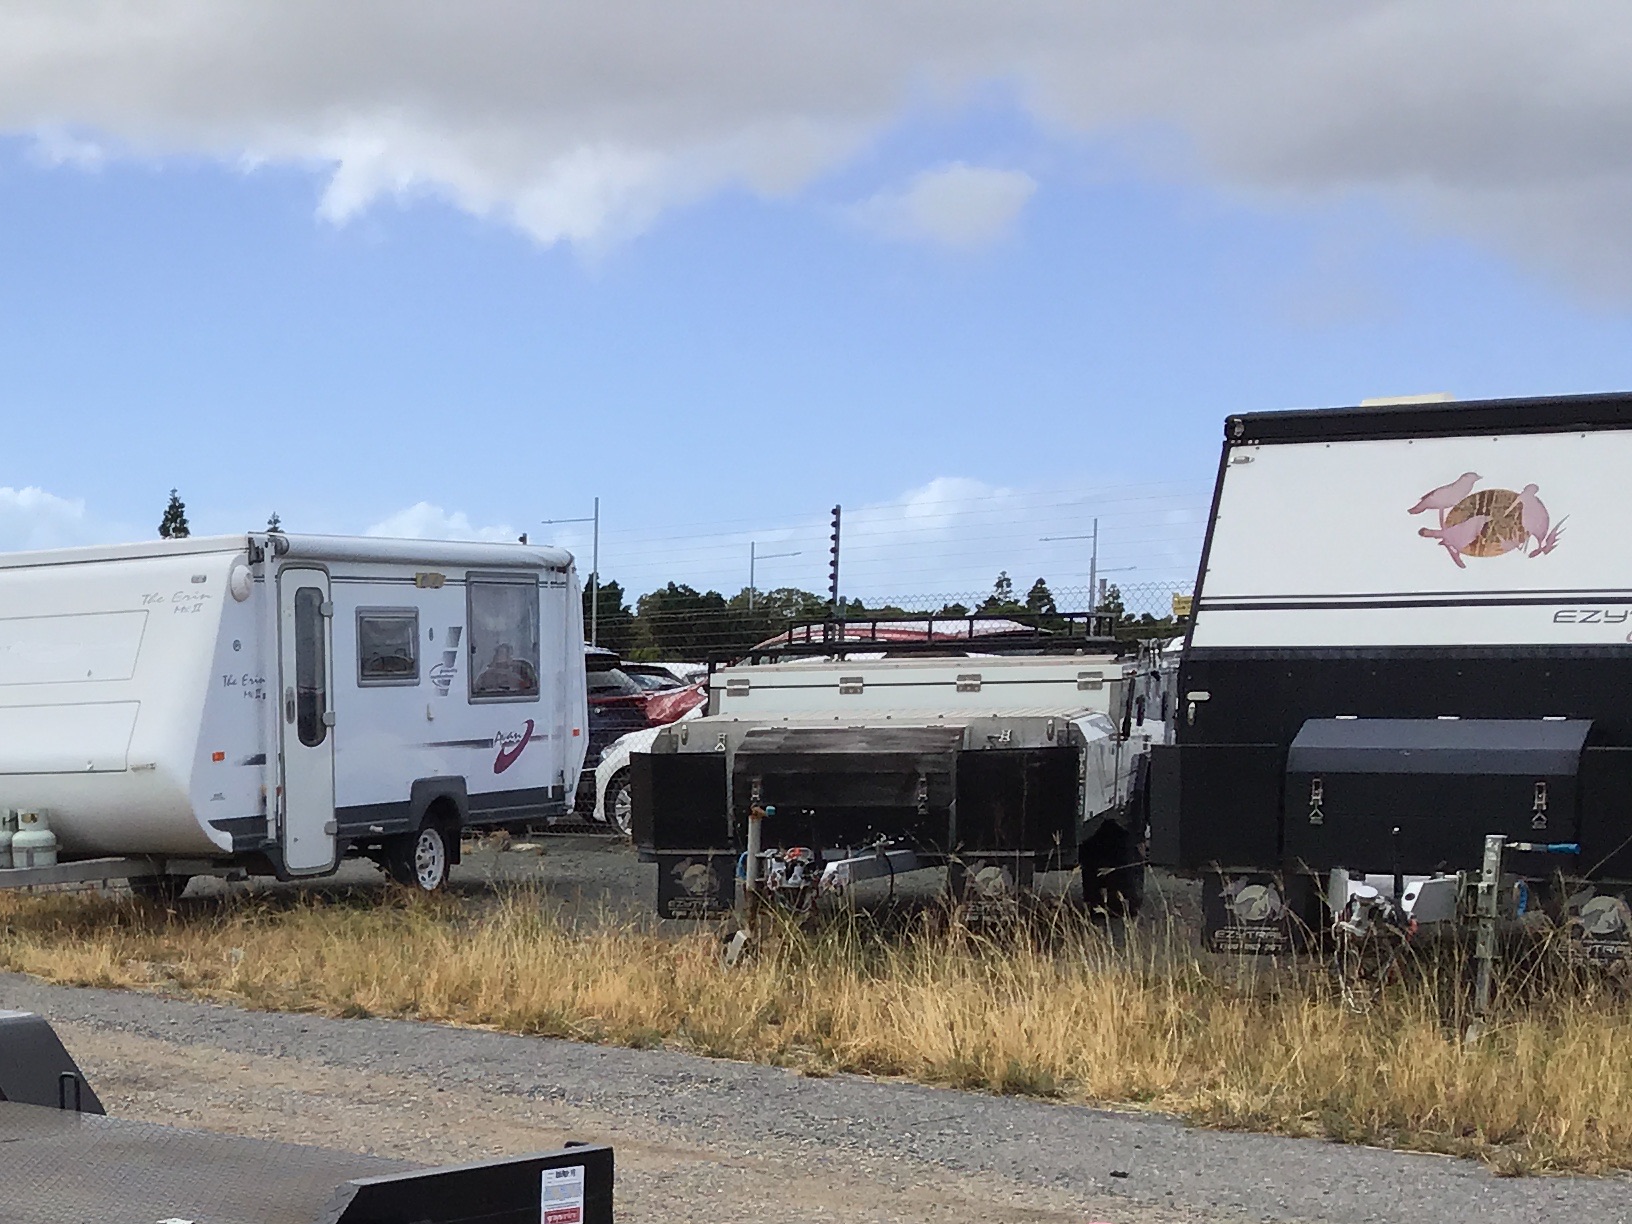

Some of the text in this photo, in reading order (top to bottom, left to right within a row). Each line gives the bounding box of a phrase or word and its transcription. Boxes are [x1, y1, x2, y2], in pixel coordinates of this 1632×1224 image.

[142, 591, 213, 605] The Erin
[1553, 609, 1632, 623] EZY
[222, 674, 237, 687] The
